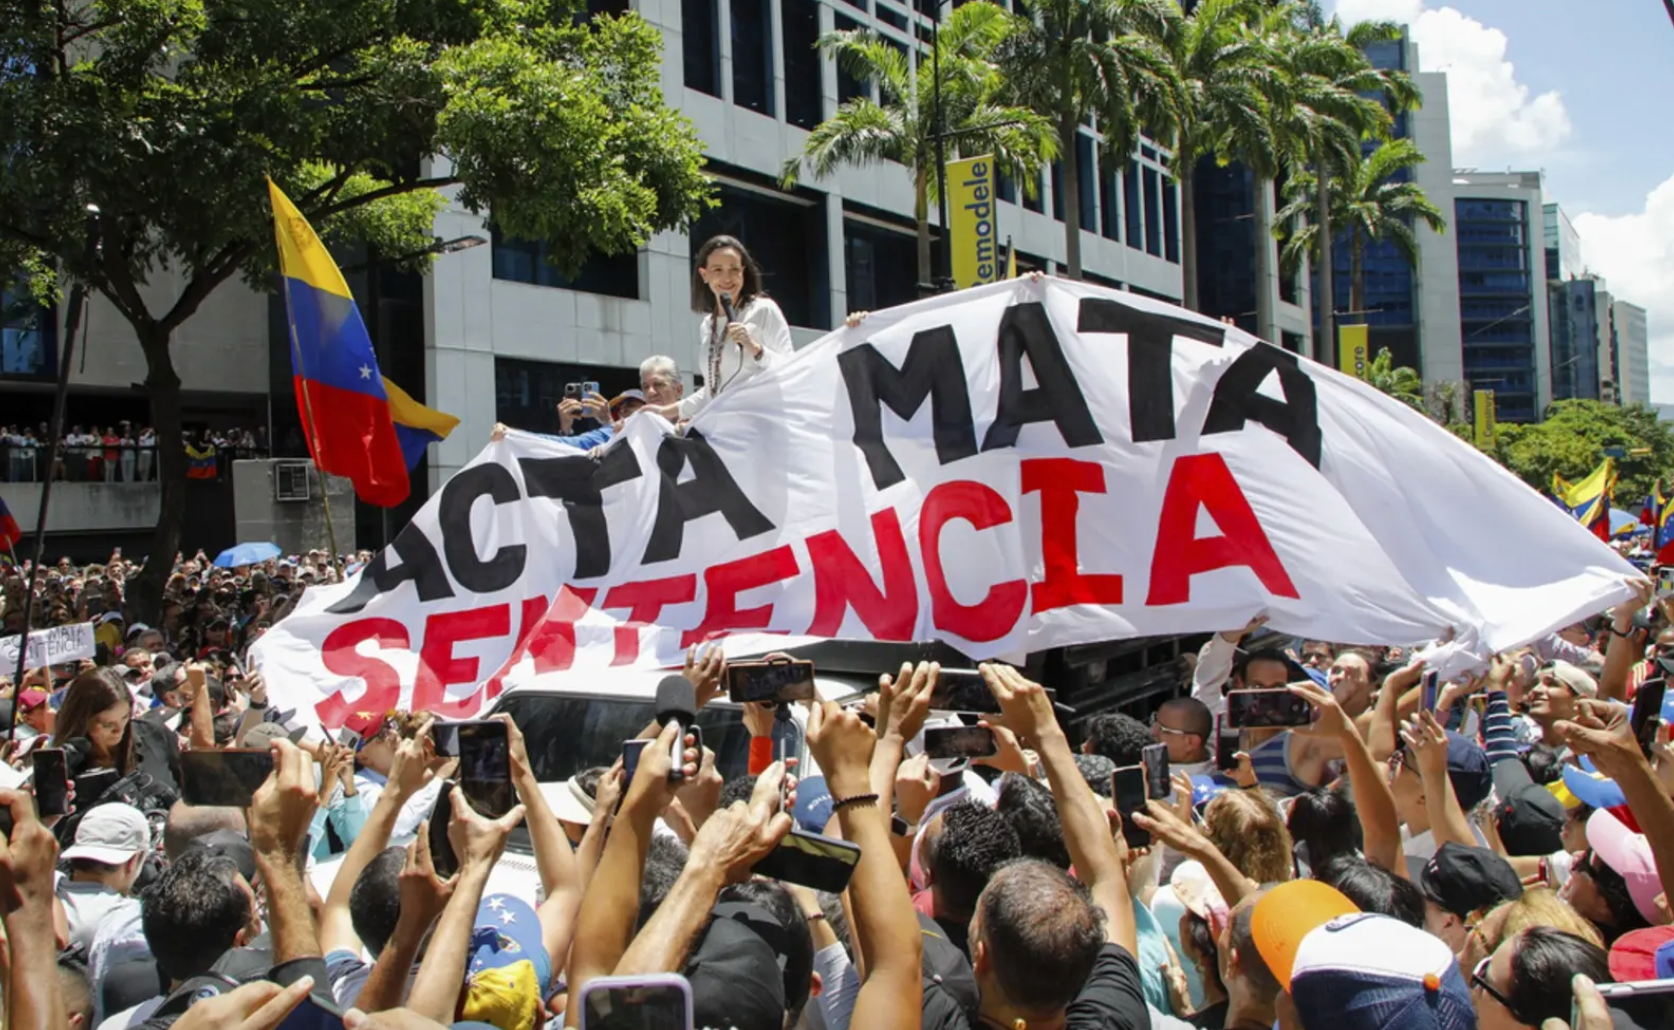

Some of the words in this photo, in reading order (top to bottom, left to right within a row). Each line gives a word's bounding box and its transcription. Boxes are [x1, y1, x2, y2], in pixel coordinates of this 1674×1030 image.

[315, 452, 1301, 728] SENTENCIA
[324, 428, 776, 613] ACTA
[837, 298, 1322, 490] MATA
